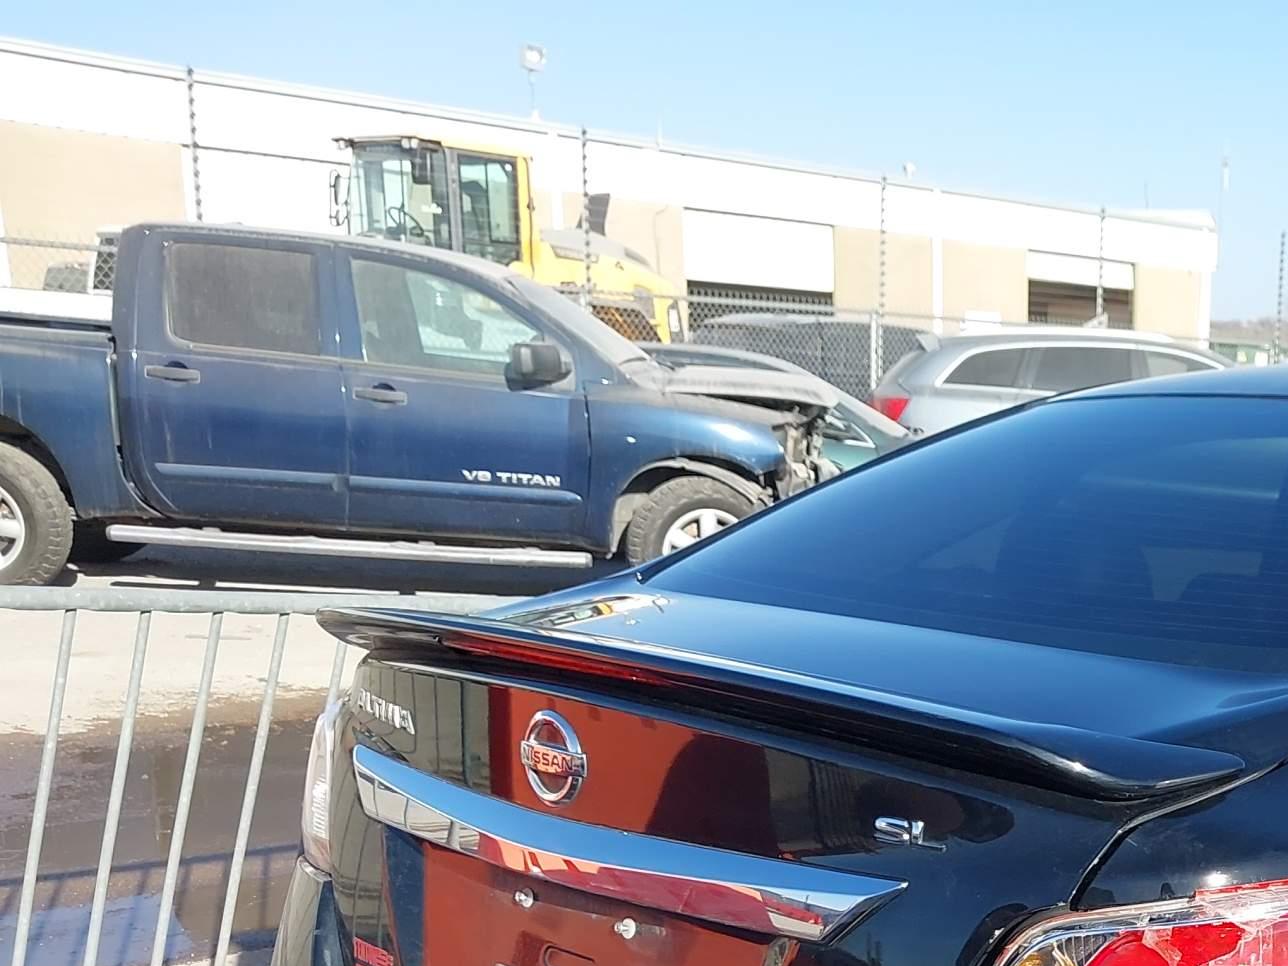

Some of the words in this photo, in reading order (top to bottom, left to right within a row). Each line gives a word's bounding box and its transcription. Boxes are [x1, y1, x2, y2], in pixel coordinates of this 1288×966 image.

[461, 469, 492, 482] V8
[495, 471, 561, 487] TITAN
[357, 686, 416, 735] ALTIMA
[521, 743, 574, 771] NISSAN
[873, 816, 947, 853] SL
